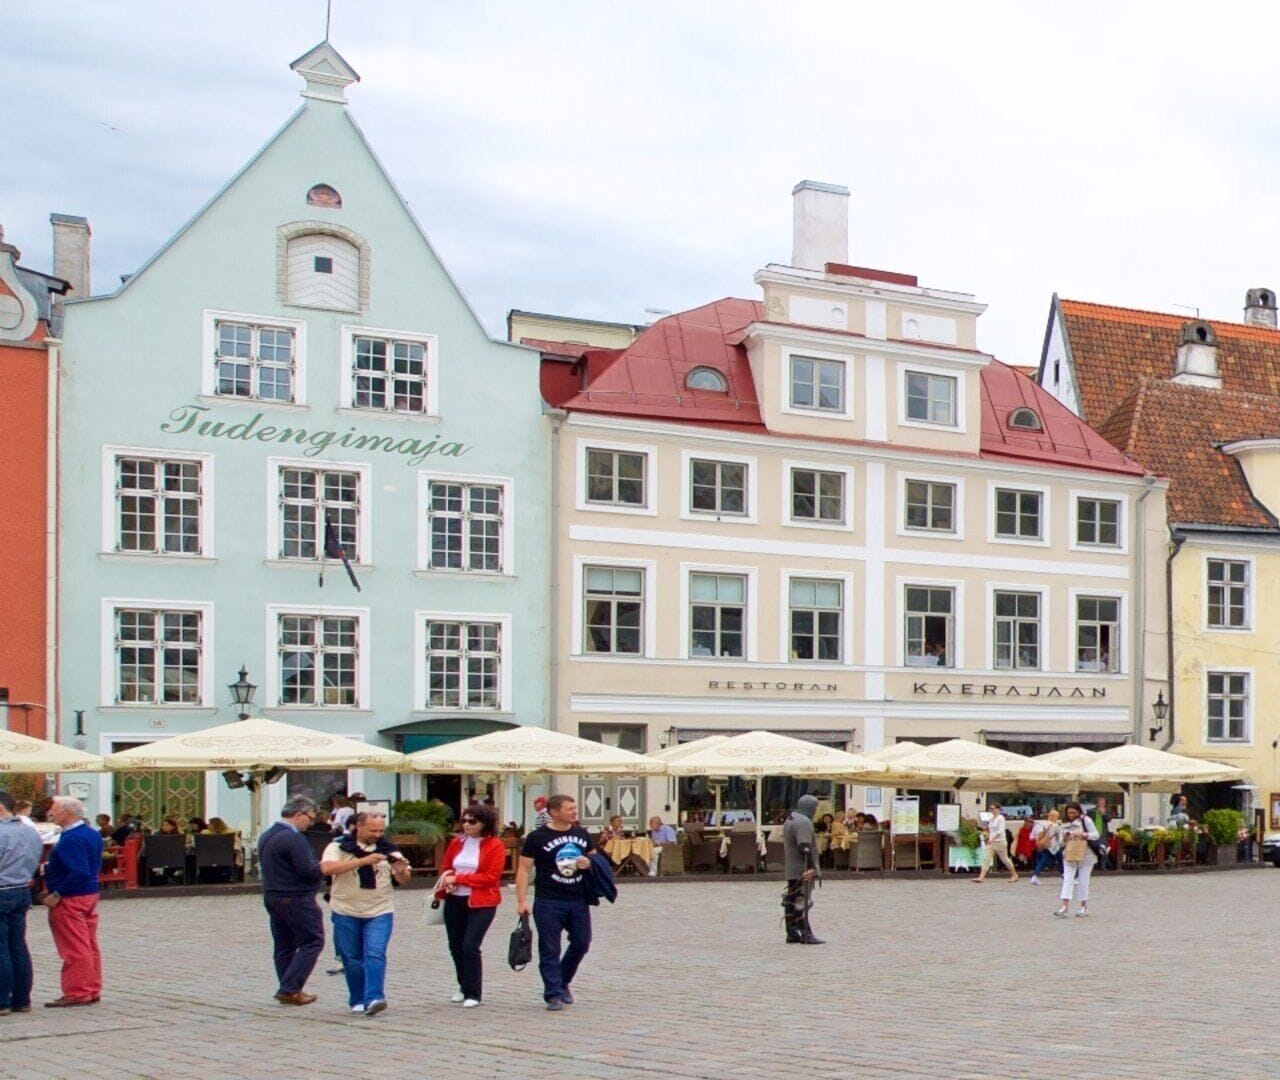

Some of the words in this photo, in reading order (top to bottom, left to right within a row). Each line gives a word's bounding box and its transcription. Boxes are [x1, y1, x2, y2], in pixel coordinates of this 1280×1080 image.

[160, 404, 474, 466] Tudengimaja
[708, 680, 838, 692] RESTORAN
[913, 682, 1107, 698] KAERAJAAN
